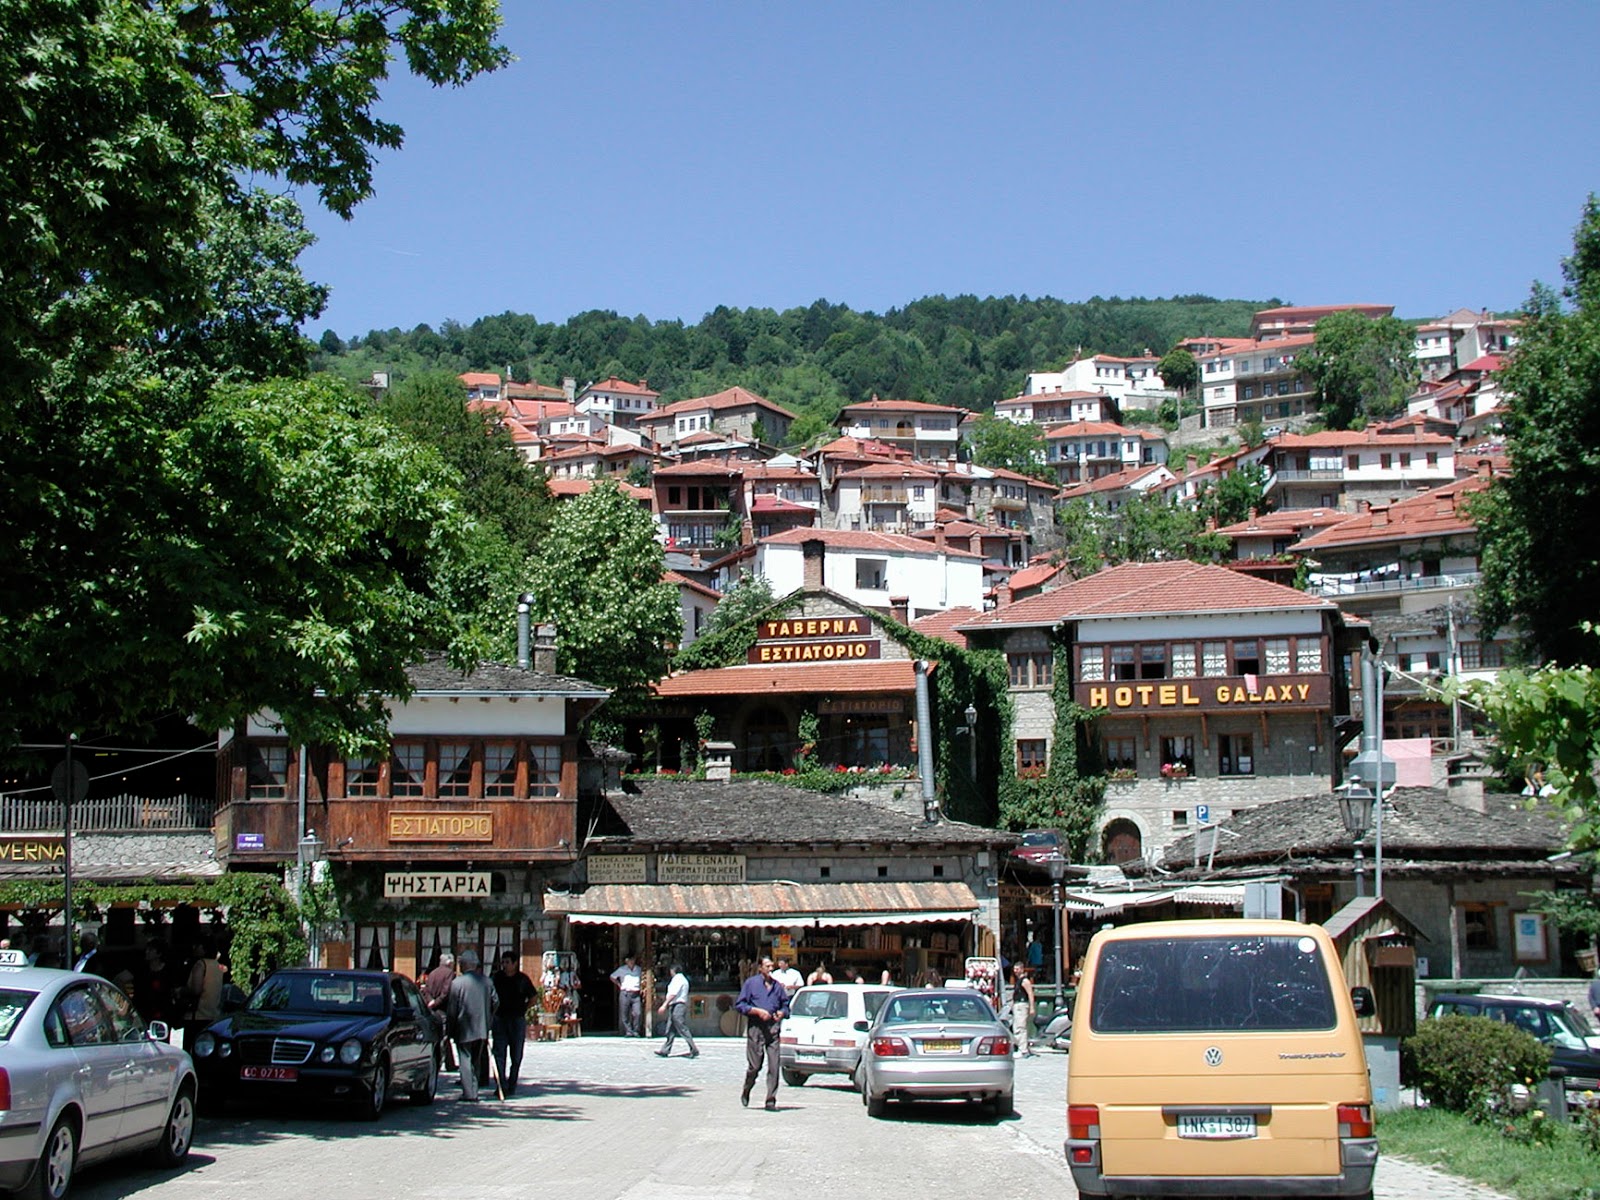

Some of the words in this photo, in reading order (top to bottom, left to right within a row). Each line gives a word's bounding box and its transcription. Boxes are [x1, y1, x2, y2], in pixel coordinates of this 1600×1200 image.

[767, 620, 859, 636] ΤΑΒΕΡΝΑ
[760, 643, 867, 662] ΕΣΤΙΑΤΟΡΙΟ
[1090, 685, 1200, 708] HOTEL
[1198, 806, 1206, 818] P
[391, 817, 490, 836] ΕΣΤΙΑΤΟΡΙΟ
[387, 876, 488, 894] ΨΗΣΤΑΡΙΑ
